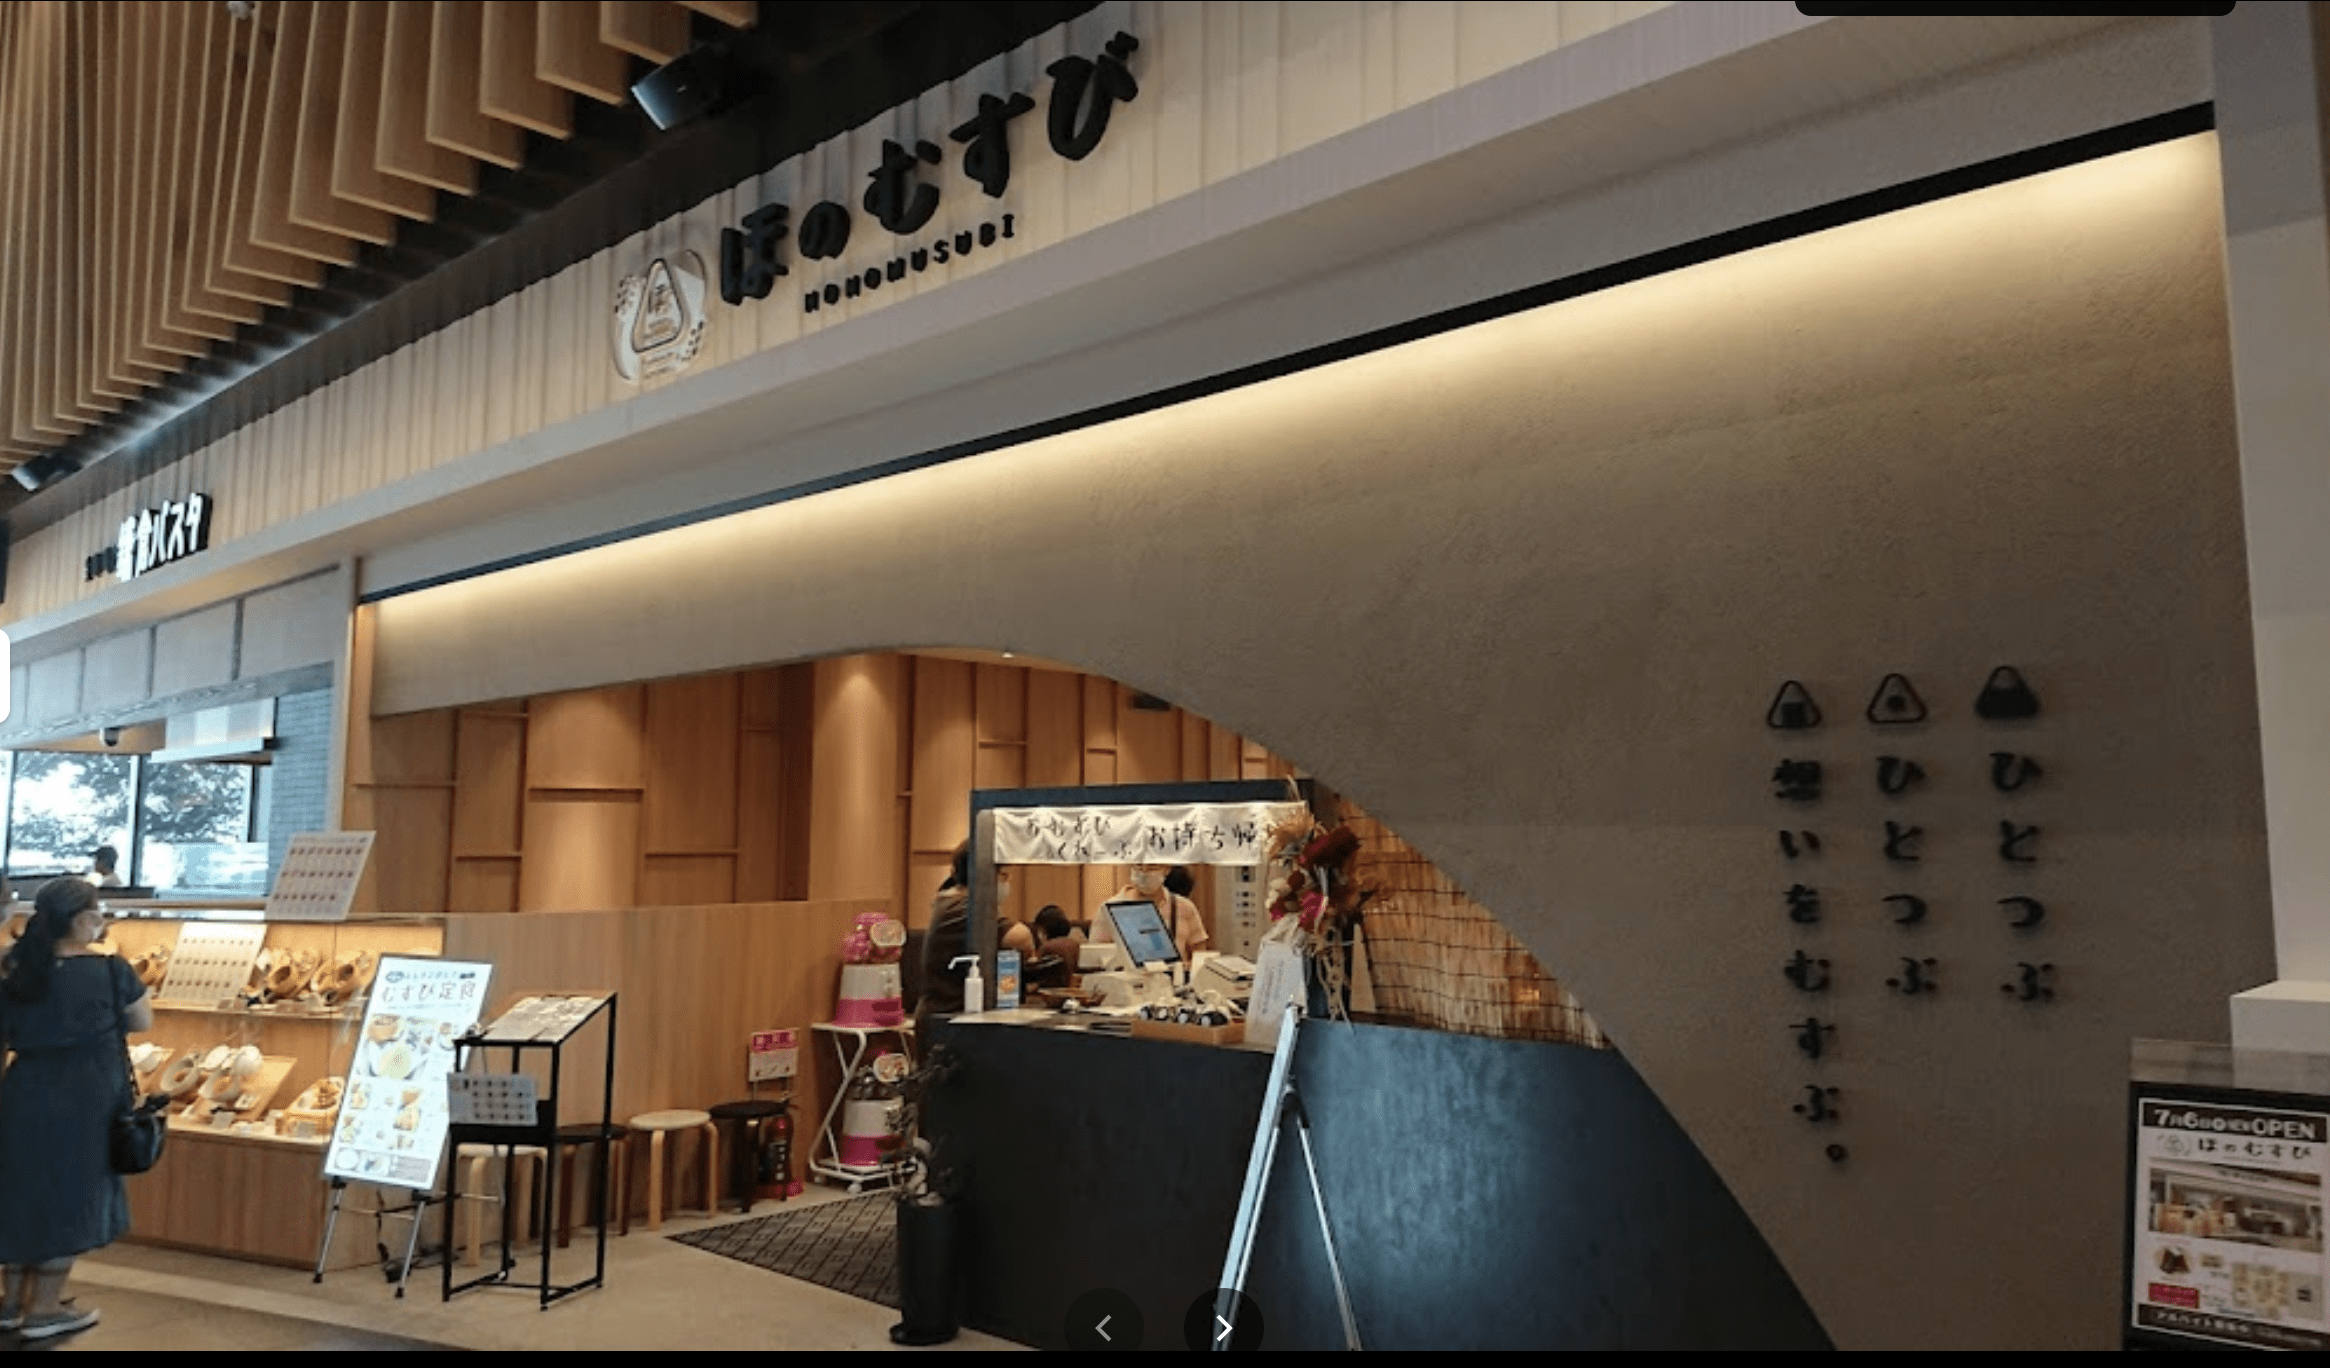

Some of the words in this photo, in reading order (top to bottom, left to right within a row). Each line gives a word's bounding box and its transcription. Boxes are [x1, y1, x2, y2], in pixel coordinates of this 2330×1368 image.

[720, 31, 1139, 305] ほのむすび
[805, 213, 1014, 313] HONOMUSUBI
[1876, 755, 1938, 996] ひとつぶ
[1989, 752, 2056, 1000] ひとつぶ
